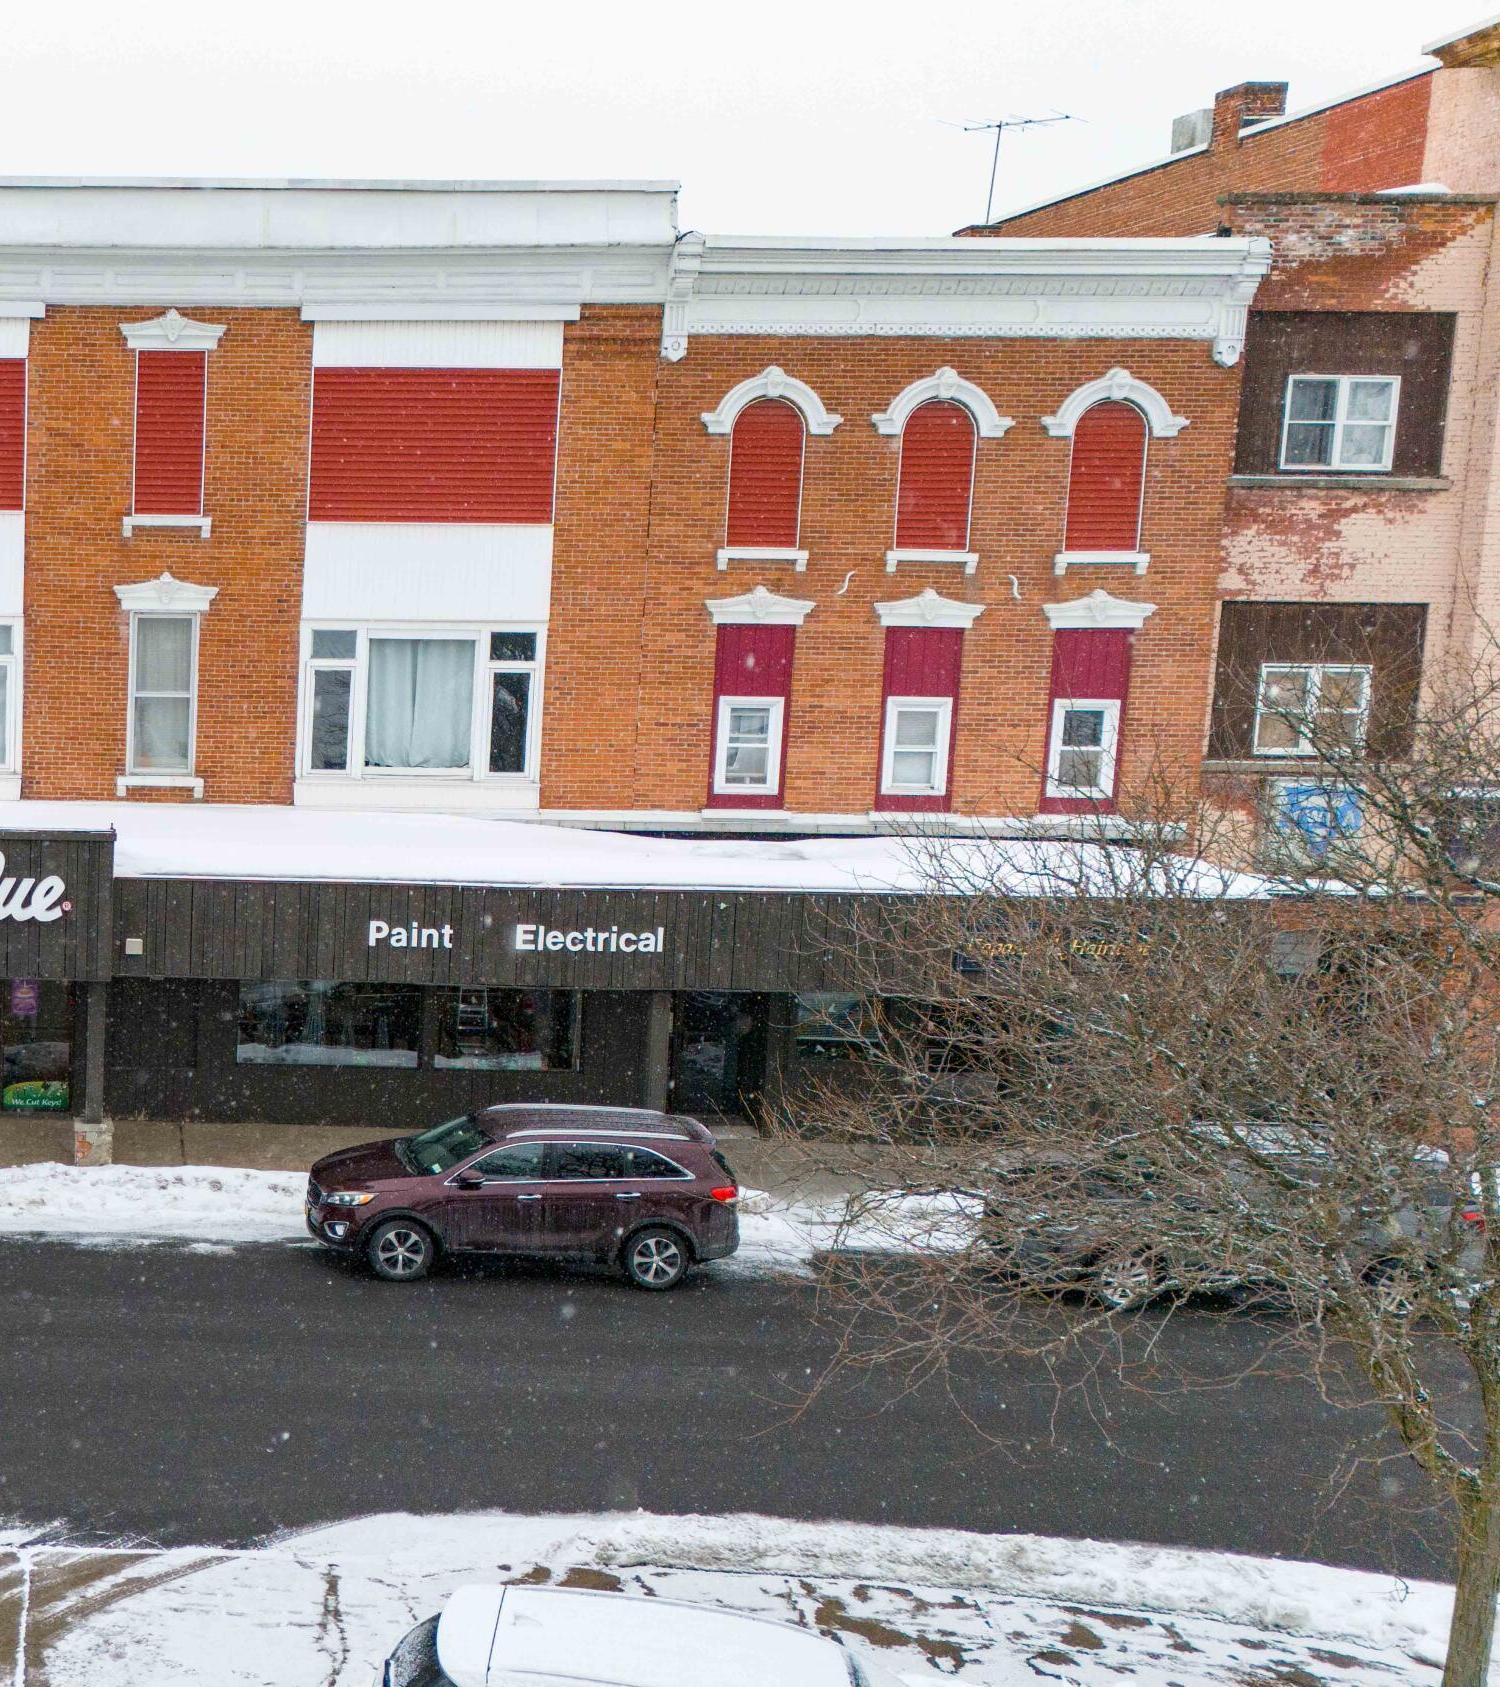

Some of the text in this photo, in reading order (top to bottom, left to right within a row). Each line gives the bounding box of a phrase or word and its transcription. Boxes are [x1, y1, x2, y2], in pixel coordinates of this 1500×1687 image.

[368, 920, 454, 949] Paint
[515, 924, 665, 953] Electrical
[11, 1098, 62, 1108] We Cut Keys!
